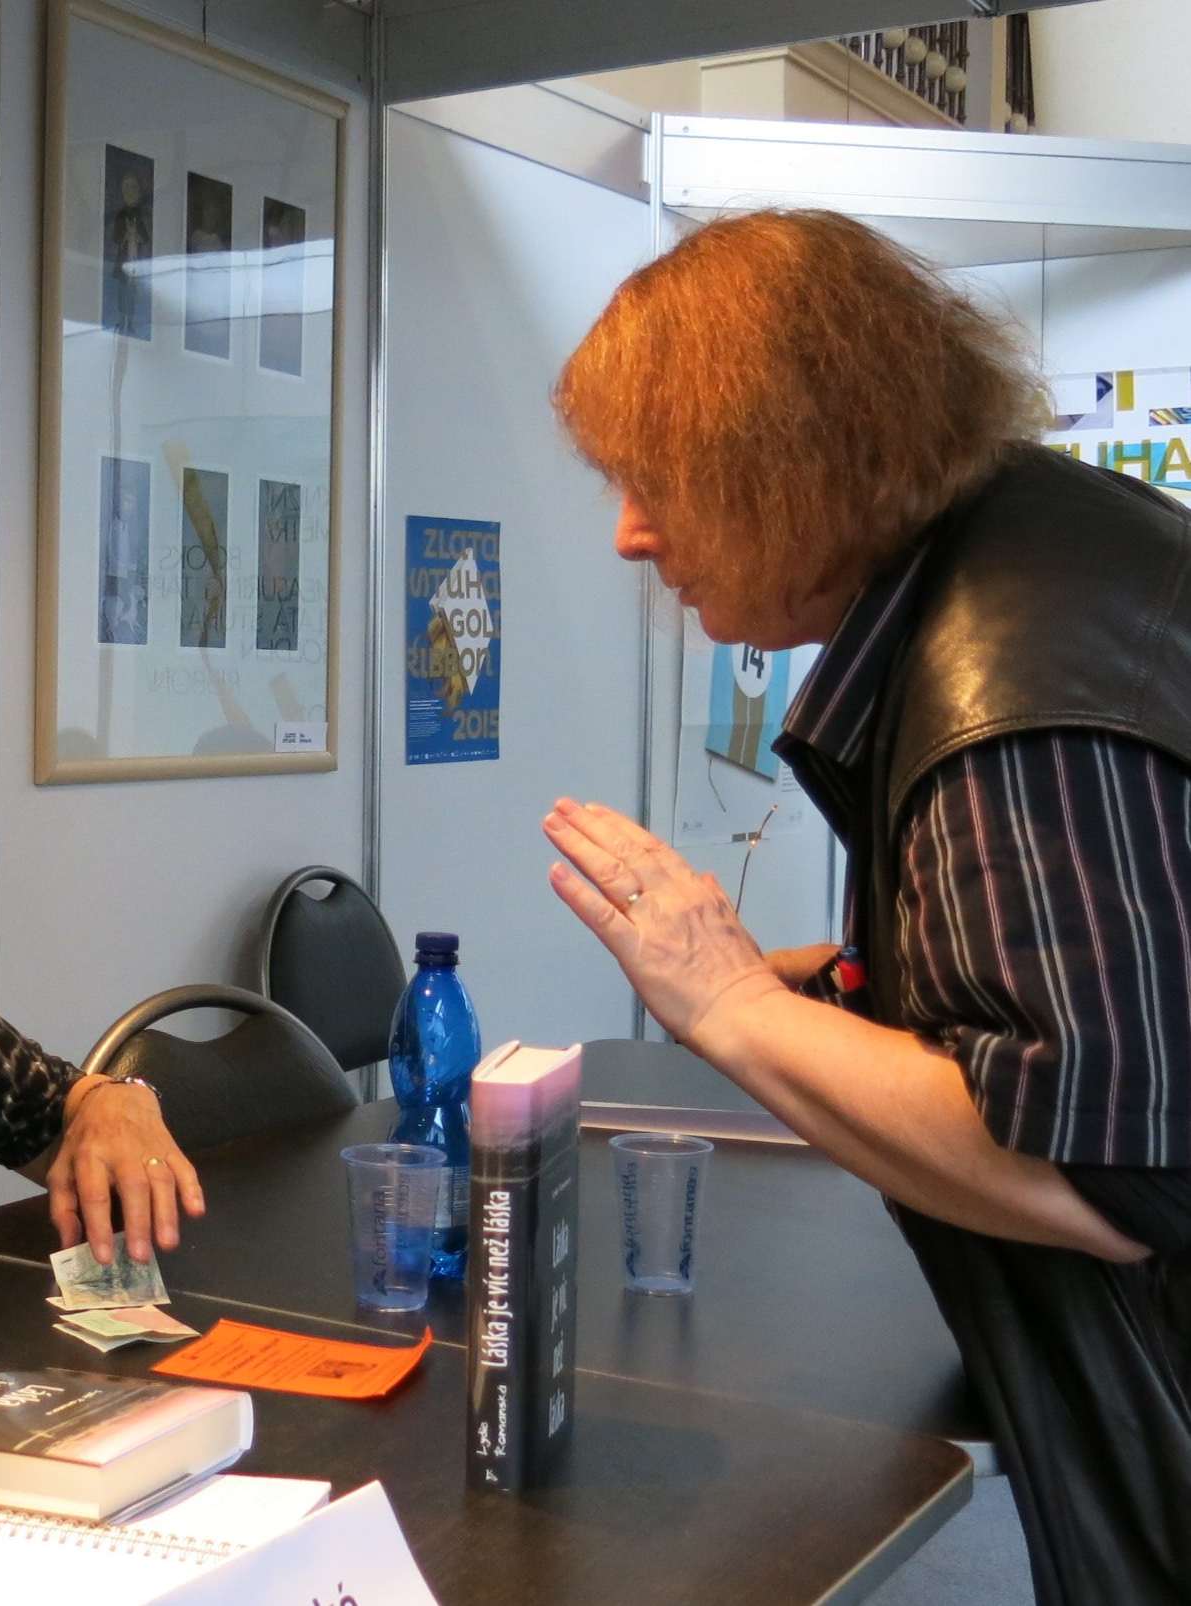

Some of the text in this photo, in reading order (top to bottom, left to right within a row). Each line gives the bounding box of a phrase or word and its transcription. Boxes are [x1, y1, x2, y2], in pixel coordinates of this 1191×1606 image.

[481, 1190, 513, 1368] Láska je víc než láska
